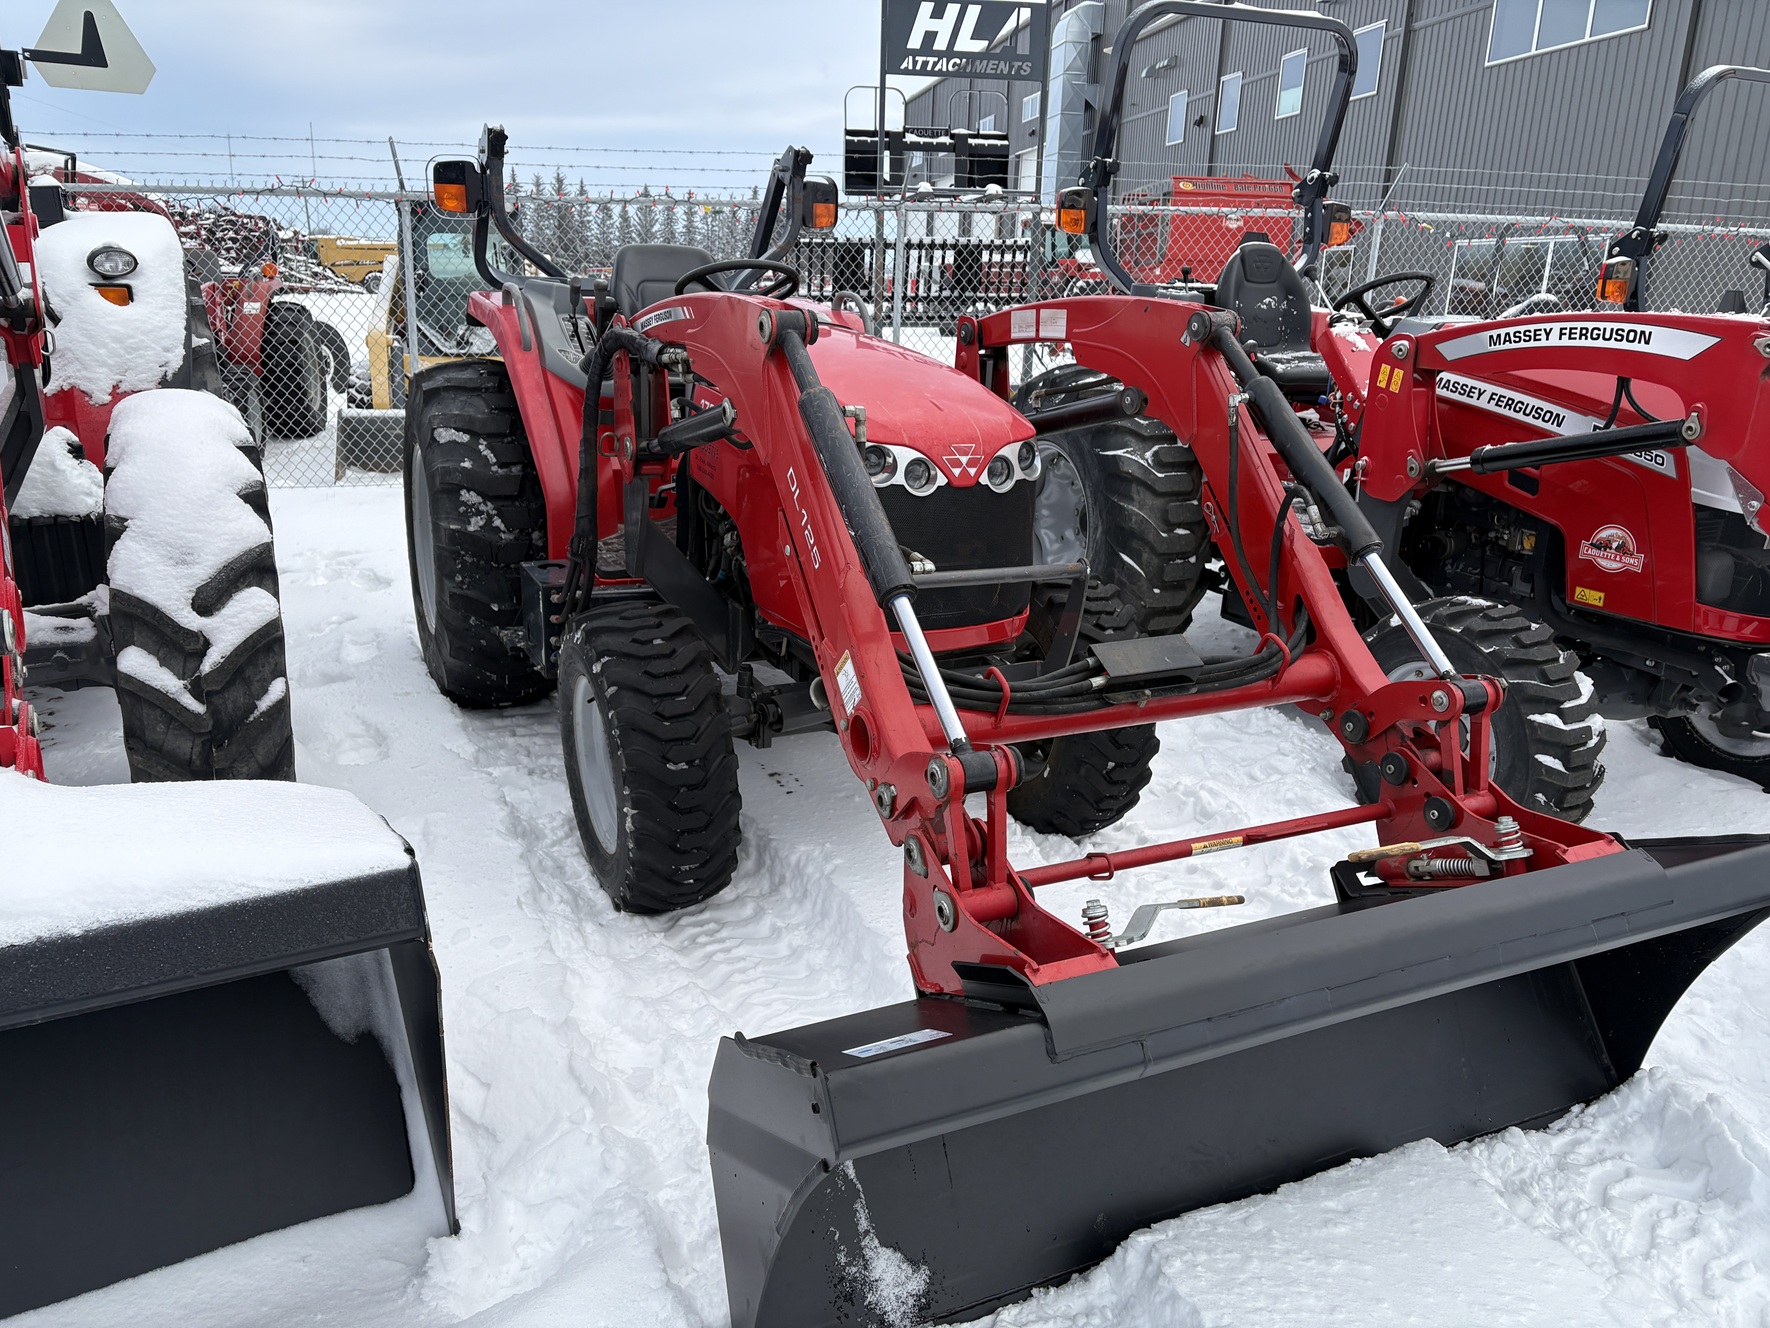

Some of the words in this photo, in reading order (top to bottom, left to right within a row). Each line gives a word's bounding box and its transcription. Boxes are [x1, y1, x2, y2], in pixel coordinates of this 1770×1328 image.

[906, 1, 1032, 55] HLA
[900, 55, 1032, 76] ATTACHMENTS
[1191, 181, 1227, 191] Highline
[1233, 183, 1252, 192] Bale
[1253, 184, 1267, 192] Pro
[640, 316, 655, 330] MASSEY
[653, 309, 673, 324] FERGUSON
[1488, 328, 1554, 348] MASSEY
[1558, 327, 1653, 345] FERGUSON
[1486, 392, 1567, 429] FERGUSON
[786, 466, 821, 570] DL125
[1583, 546, 1616, 561] CAOUETTE
[1615, 553, 1620, 561] &
[1621, 555, 1639, 567] SONS
